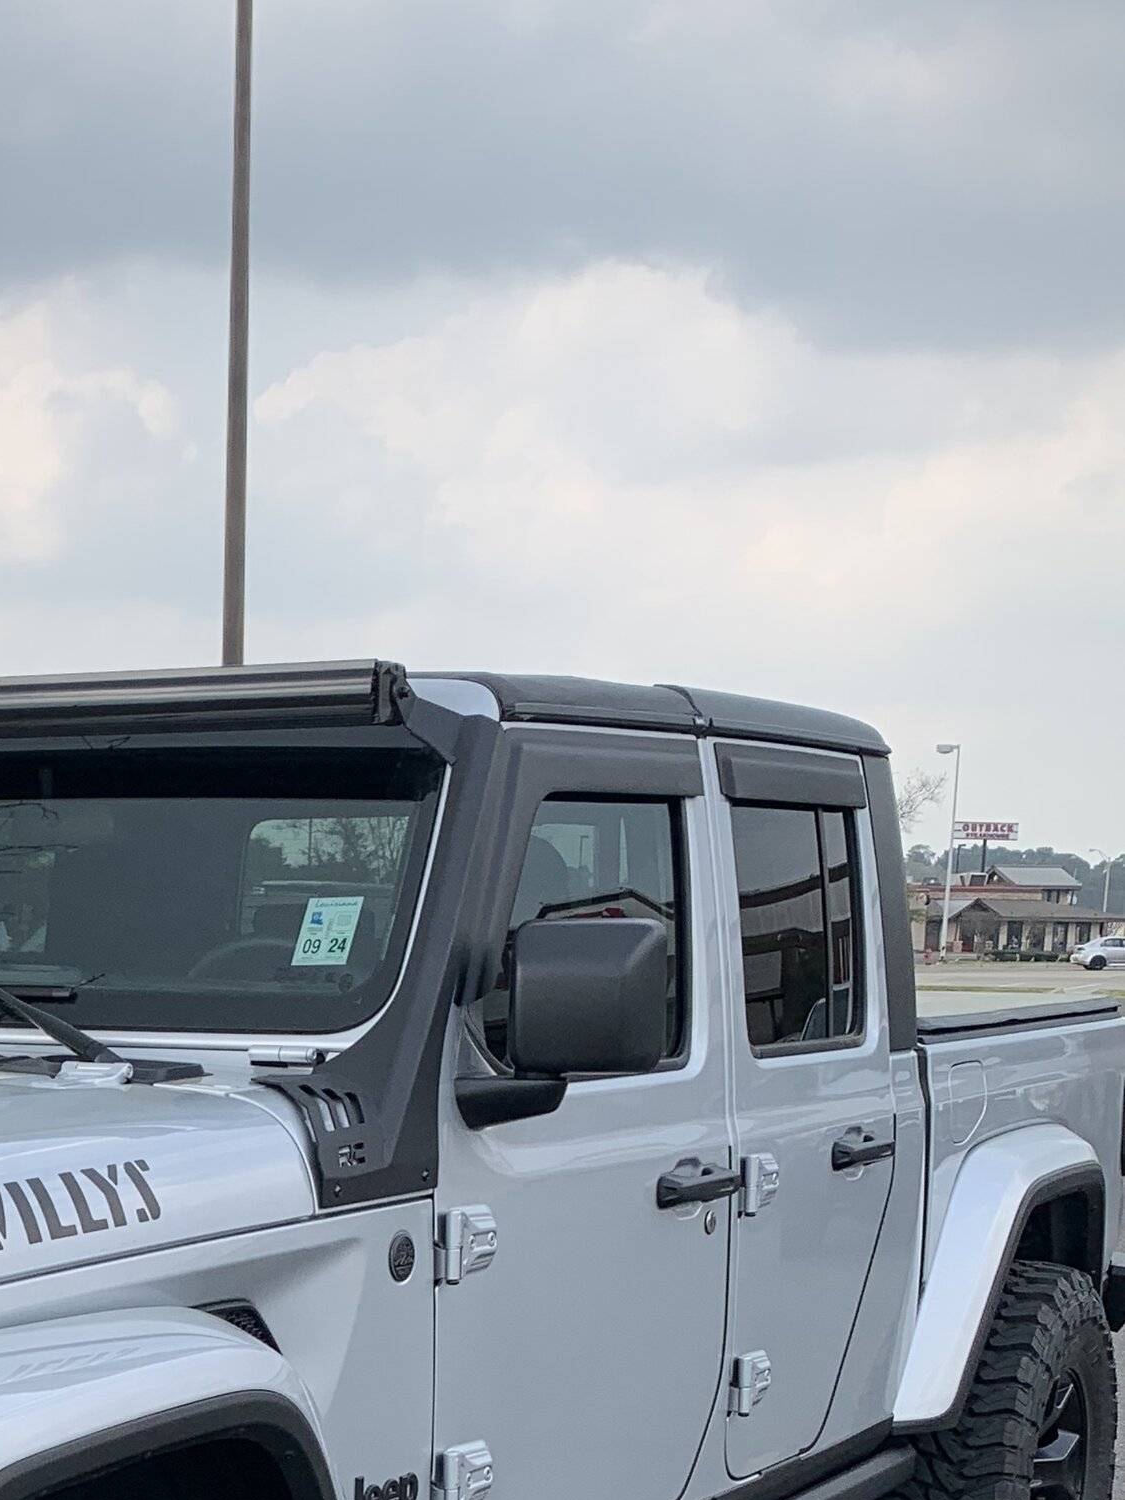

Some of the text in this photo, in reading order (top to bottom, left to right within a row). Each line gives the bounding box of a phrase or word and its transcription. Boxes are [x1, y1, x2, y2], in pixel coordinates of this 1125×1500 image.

[962, 823, 1014, 832] OUTBACK
[302, 937, 347, 954] 09 24
[338, 1142, 366, 1167] RC
